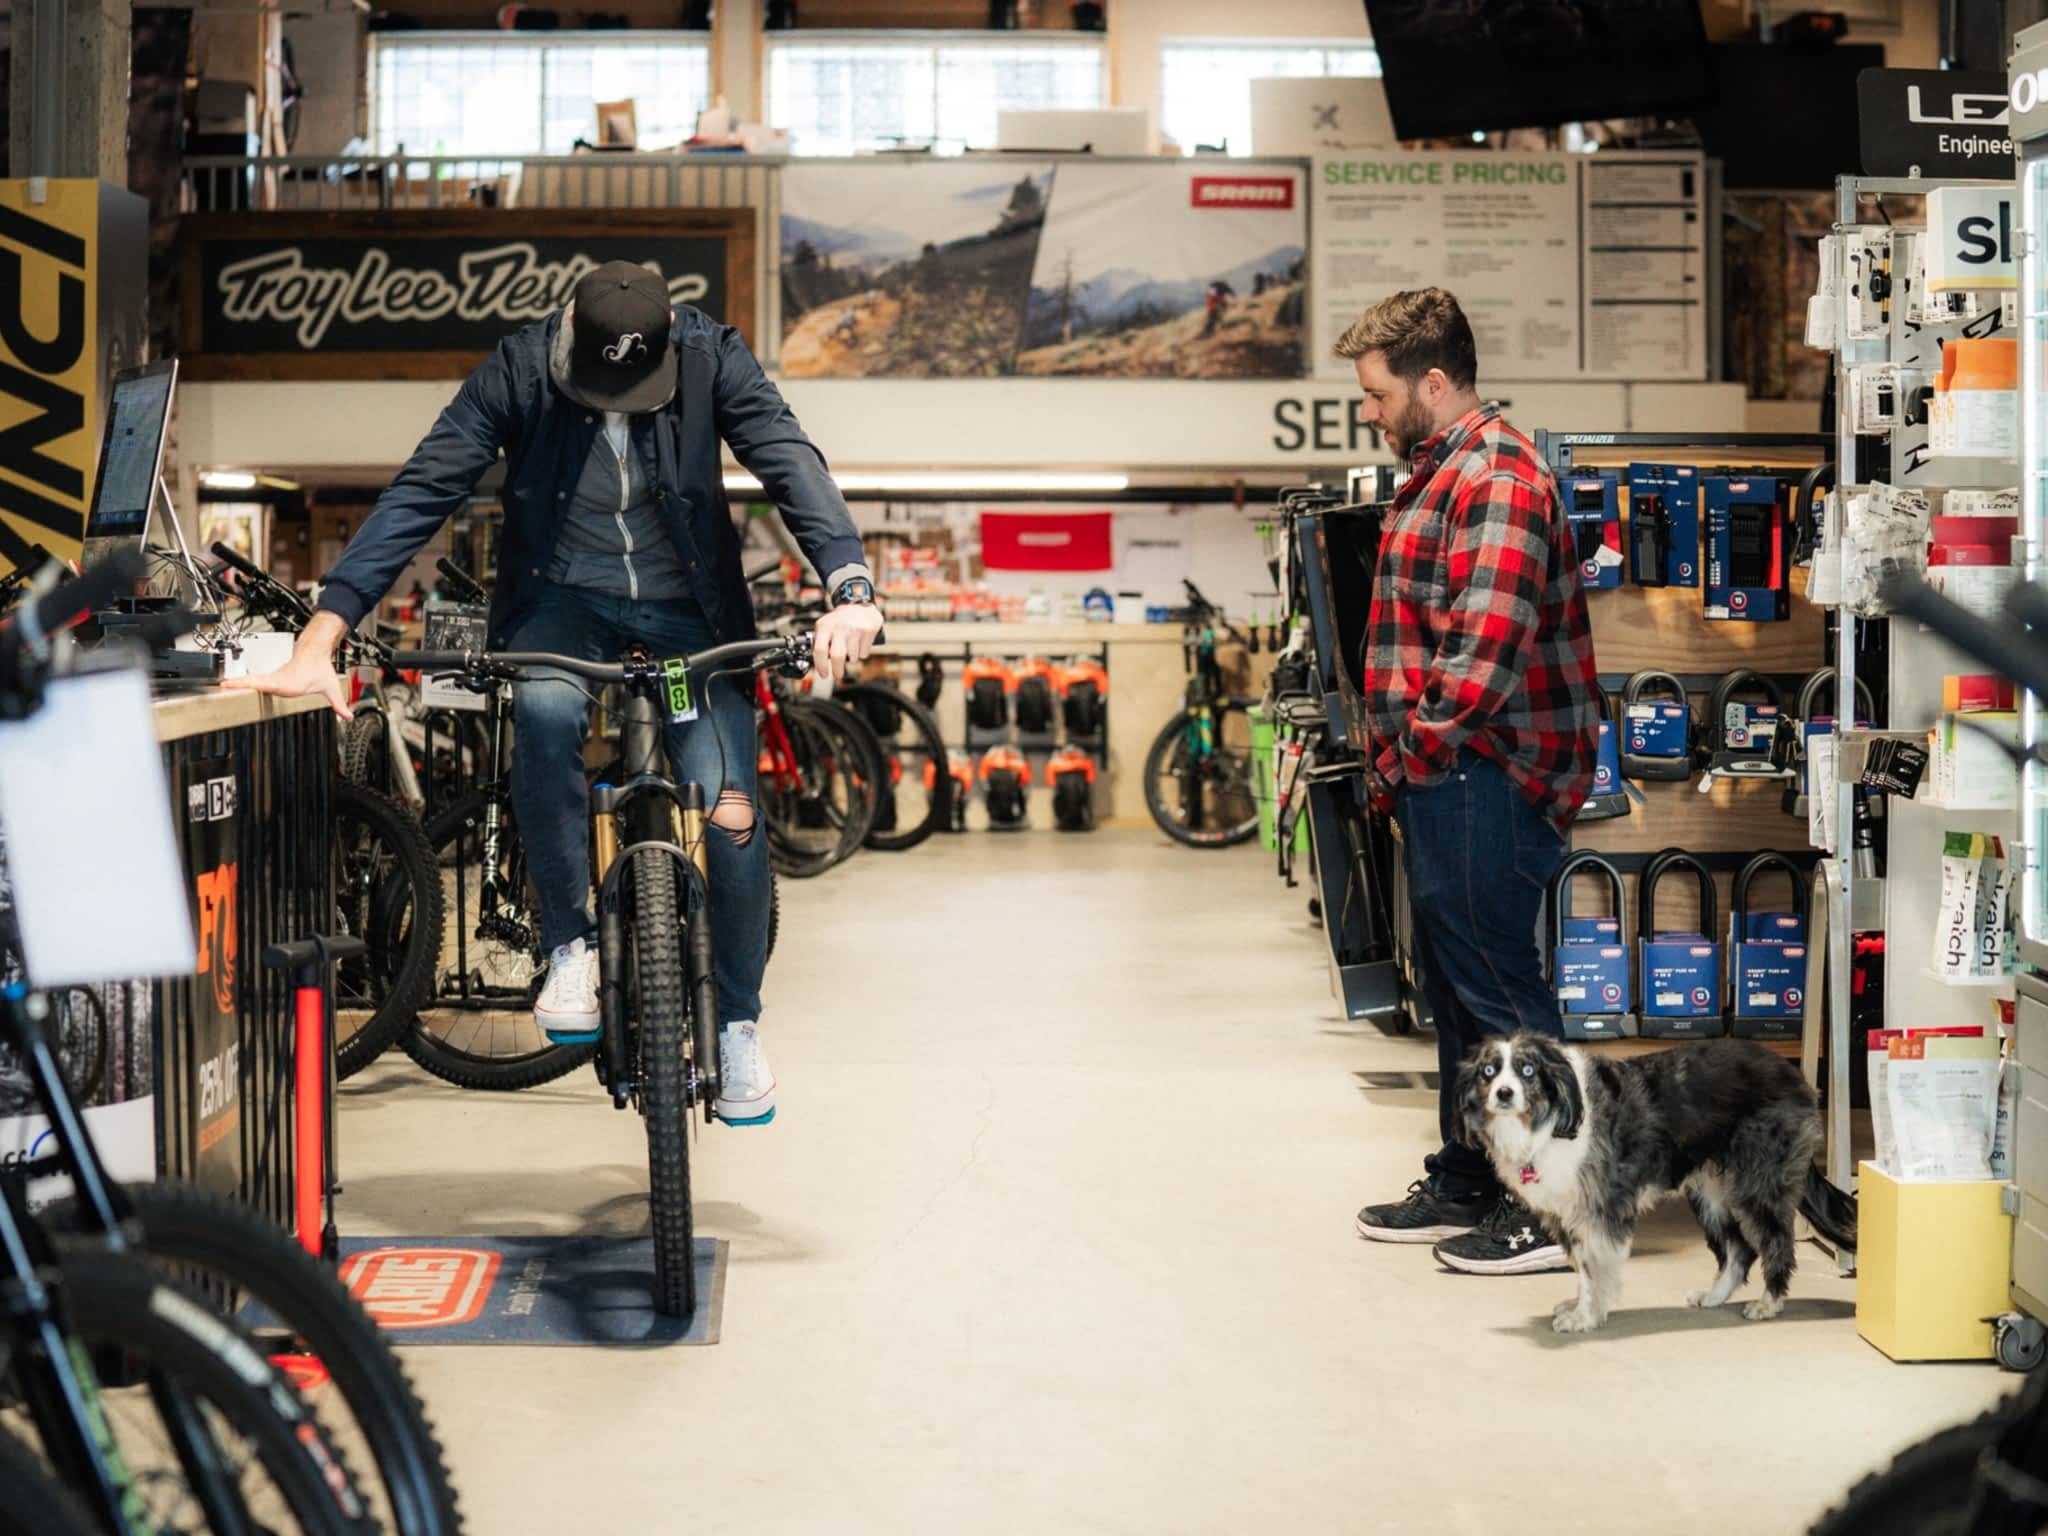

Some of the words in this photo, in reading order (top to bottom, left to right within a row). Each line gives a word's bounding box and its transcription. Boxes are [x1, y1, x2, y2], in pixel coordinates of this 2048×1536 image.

[1324, 161, 1443, 185] SERVICE
[1453, 162, 1567, 185] PRICING
[219, 248, 342, 348] Troy
[340, 248, 459, 323] Lee
[200, 1052, 224, 1120] 25%
[362, 1257, 464, 1317] ABUS
